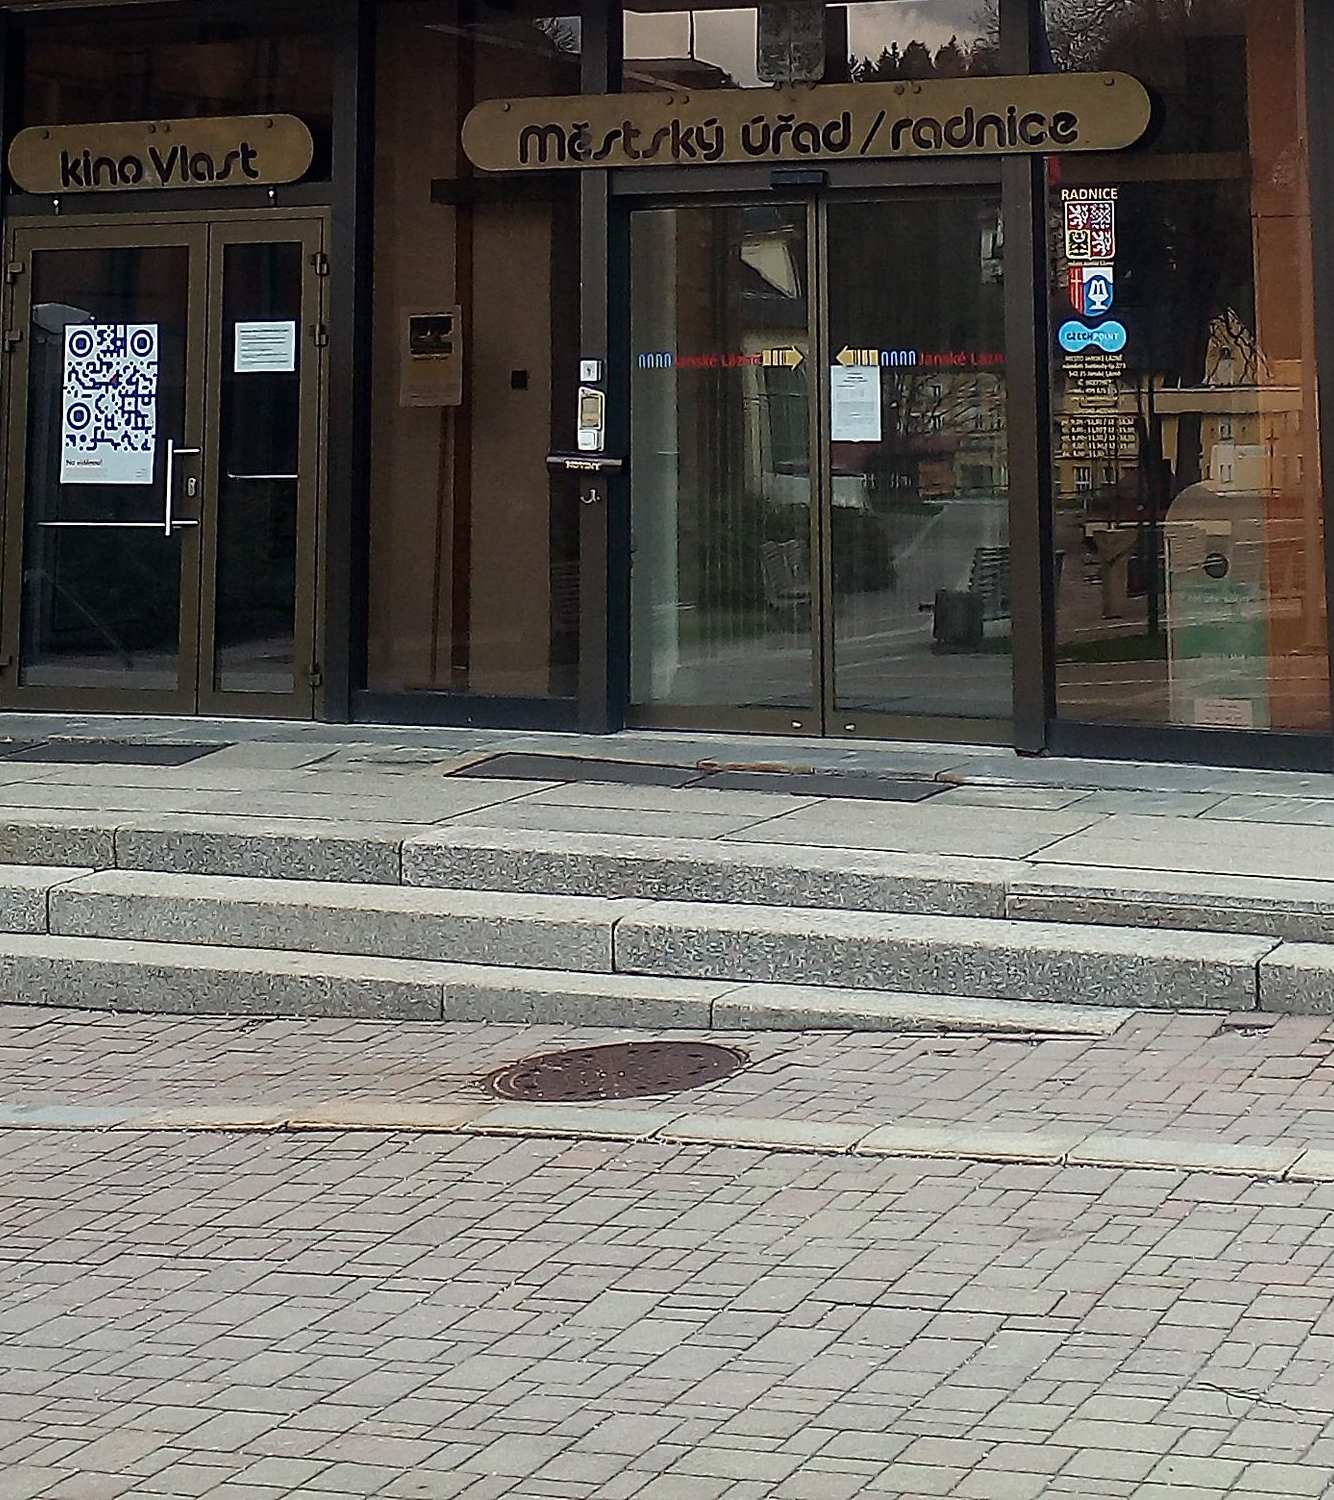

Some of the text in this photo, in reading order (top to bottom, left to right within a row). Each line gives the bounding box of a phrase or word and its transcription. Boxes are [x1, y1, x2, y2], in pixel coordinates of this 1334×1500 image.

[61, 141, 260, 187] kino Vlast
[1061, 188, 1118, 200] RADNICE
[919, 351, 1008, 366] Janské Lázn
